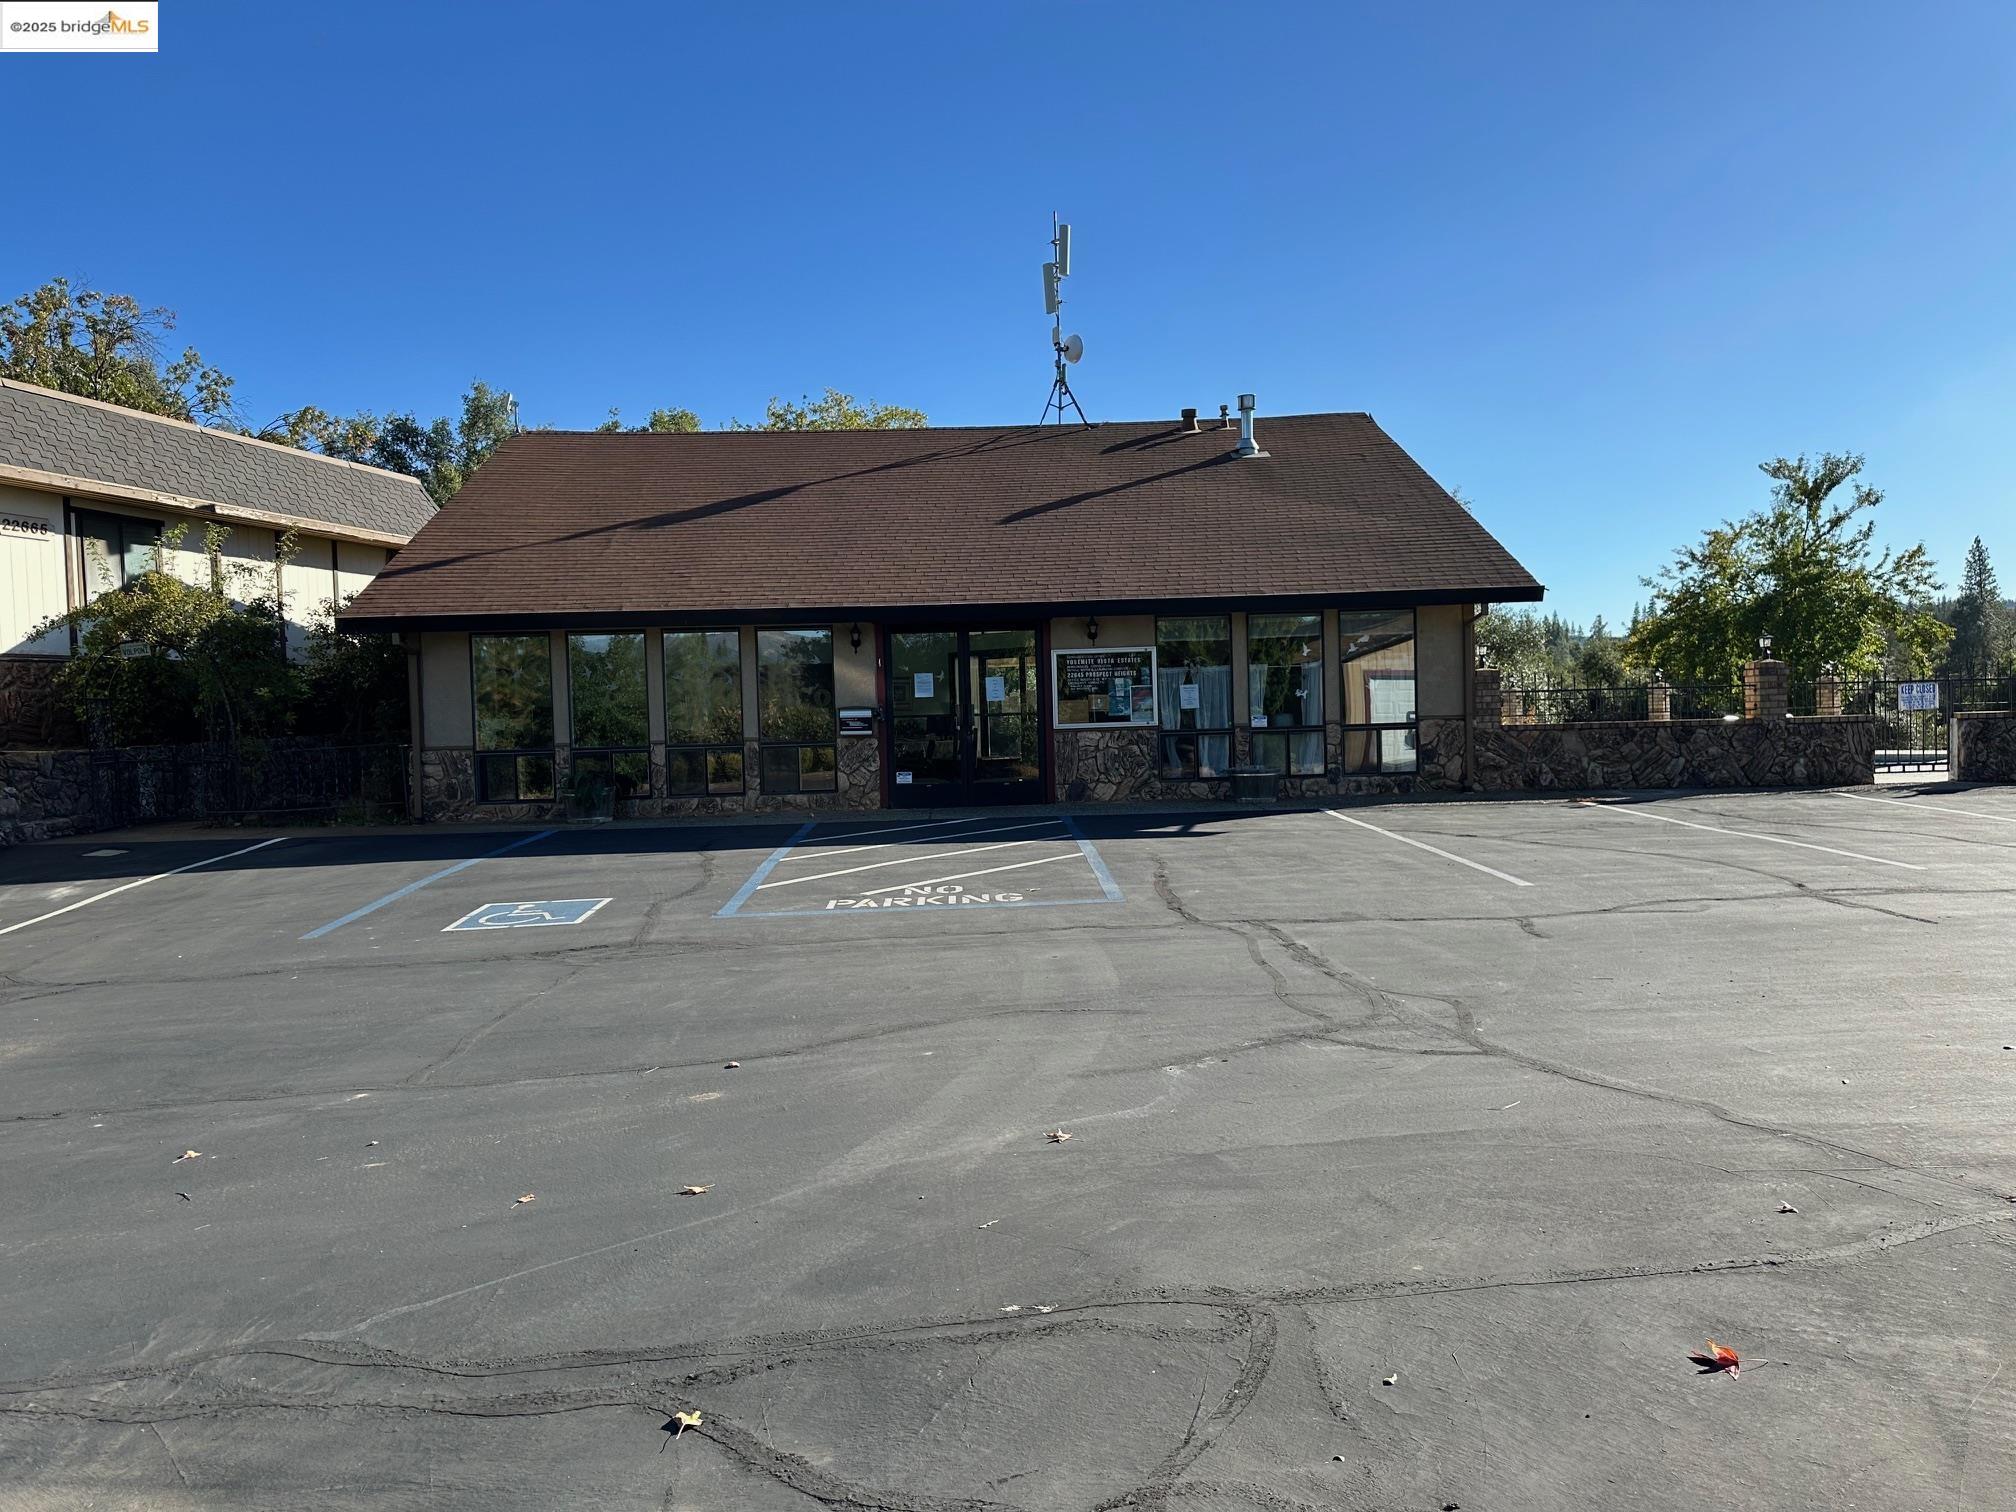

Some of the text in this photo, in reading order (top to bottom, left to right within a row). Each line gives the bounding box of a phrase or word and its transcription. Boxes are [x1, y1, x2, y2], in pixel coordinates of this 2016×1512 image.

[2, 518, 49, 536] 22665
[1901, 683, 1936, 695] KEEP CLOSED
[904, 885, 963, 895] NO
[825, 892, 1024, 910] PARKING
